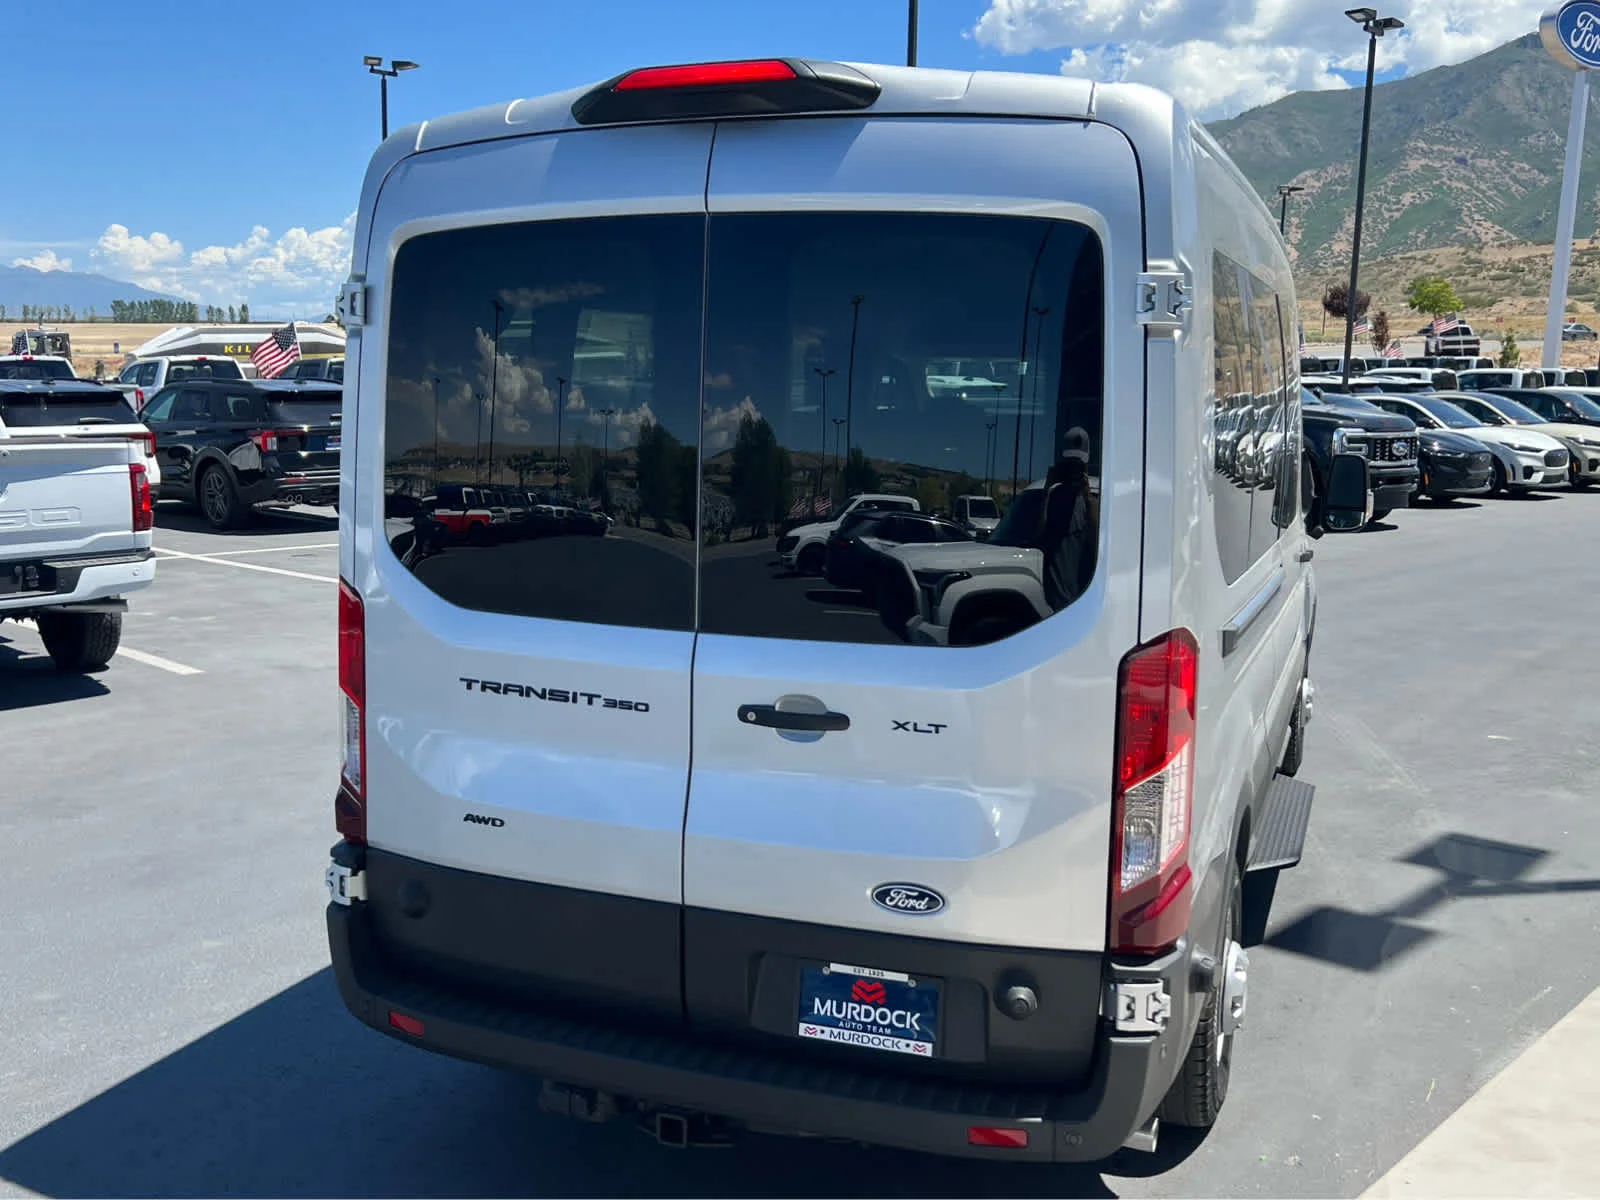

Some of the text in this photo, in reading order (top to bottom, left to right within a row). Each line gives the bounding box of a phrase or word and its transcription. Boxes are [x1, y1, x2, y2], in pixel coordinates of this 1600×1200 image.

[1571, 11, 1600, 54] For
[892, 720, 948, 734] XLT
[464, 813, 505, 828] AWD
[885, 888, 930, 911] Ford
[813, 997, 921, 1031] MURDOCK
[838, 1021, 892, 1035] AUTO TEAM
[829, 1029, 902, 1050] MURDOCK
